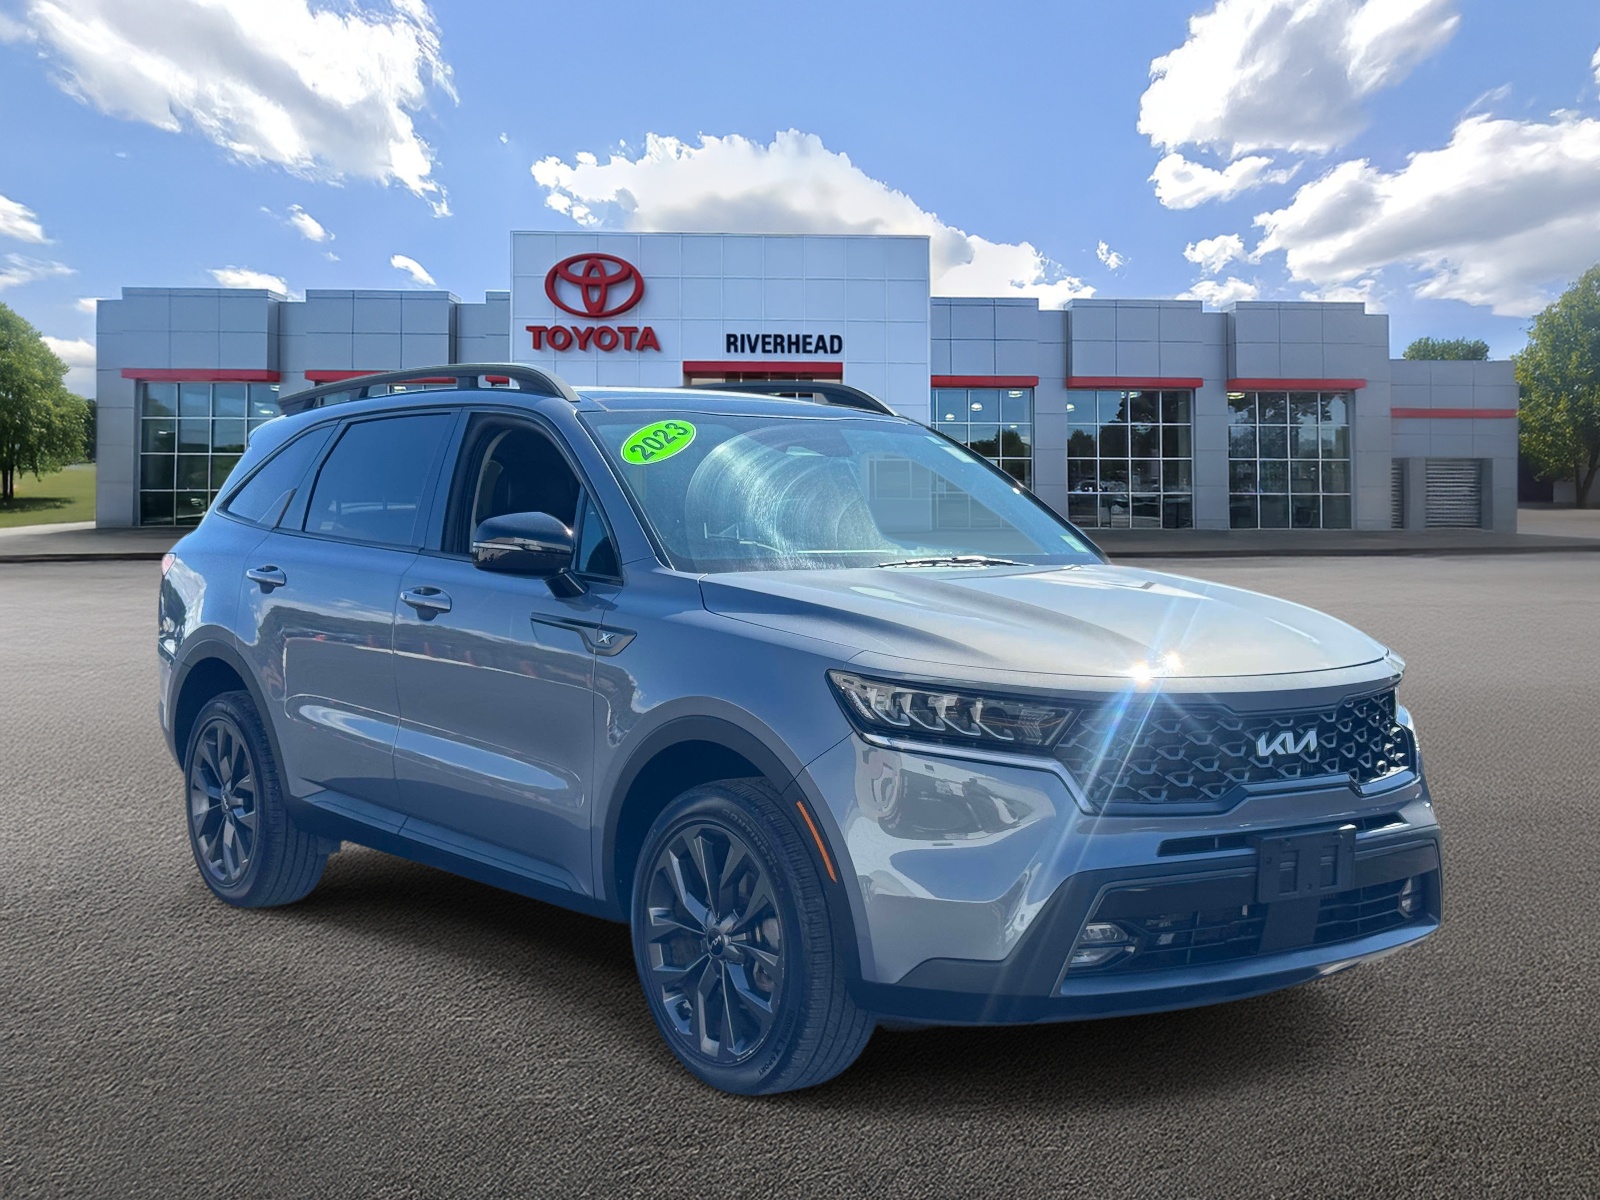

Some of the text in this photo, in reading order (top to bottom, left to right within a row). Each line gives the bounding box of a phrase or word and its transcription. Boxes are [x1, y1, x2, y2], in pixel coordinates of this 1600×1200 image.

[525, 325, 661, 352] TOYOTA
[725, 333, 843, 354] RIVERHEAD
[629, 422, 689, 461] 2023
[1256, 728, 1318, 757] KIA
